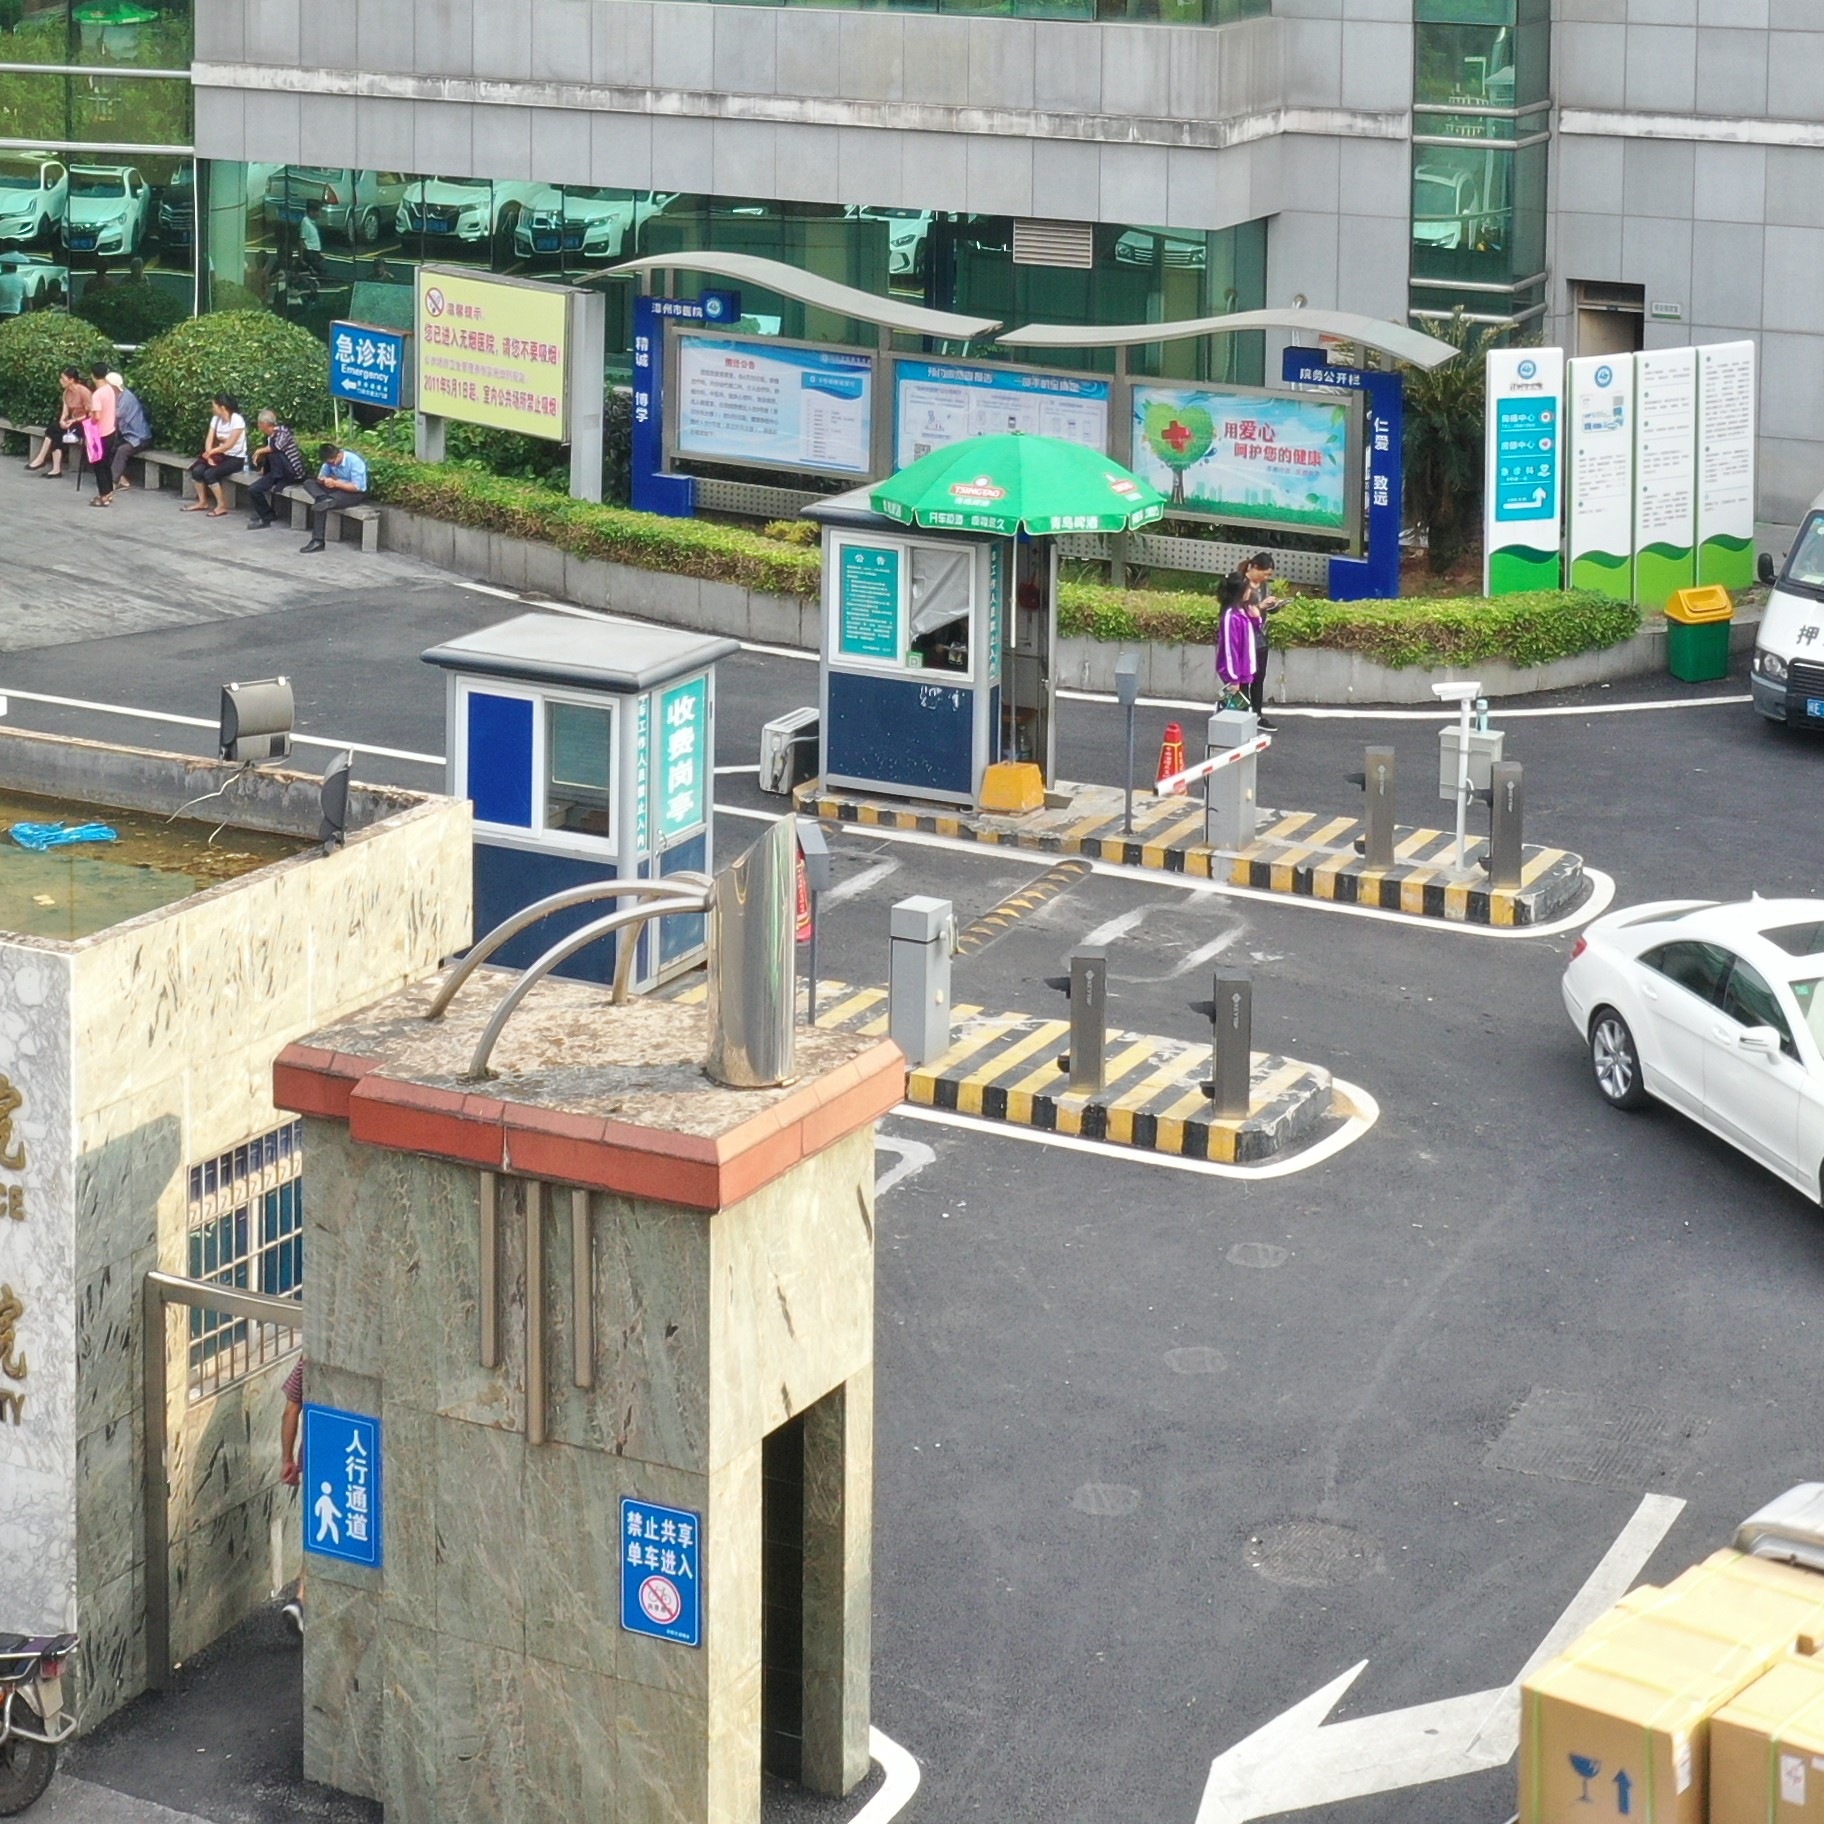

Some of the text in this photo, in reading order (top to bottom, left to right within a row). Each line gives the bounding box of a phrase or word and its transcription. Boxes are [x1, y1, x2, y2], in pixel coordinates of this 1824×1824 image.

[335, 333, 397, 372] 急诊科
[341, 364, 388, 383] Emergency
[1224, 420, 1276, 442] 用爱心
[1234, 443, 1322, 466] 呵护您的健康
[666, 695, 696, 822] 收费岗亭
[345, 1429, 368, 1543] 人行通道
[627, 1511, 694, 1549] 禁止共享
[627, 1542, 694, 1580] 单车进入
